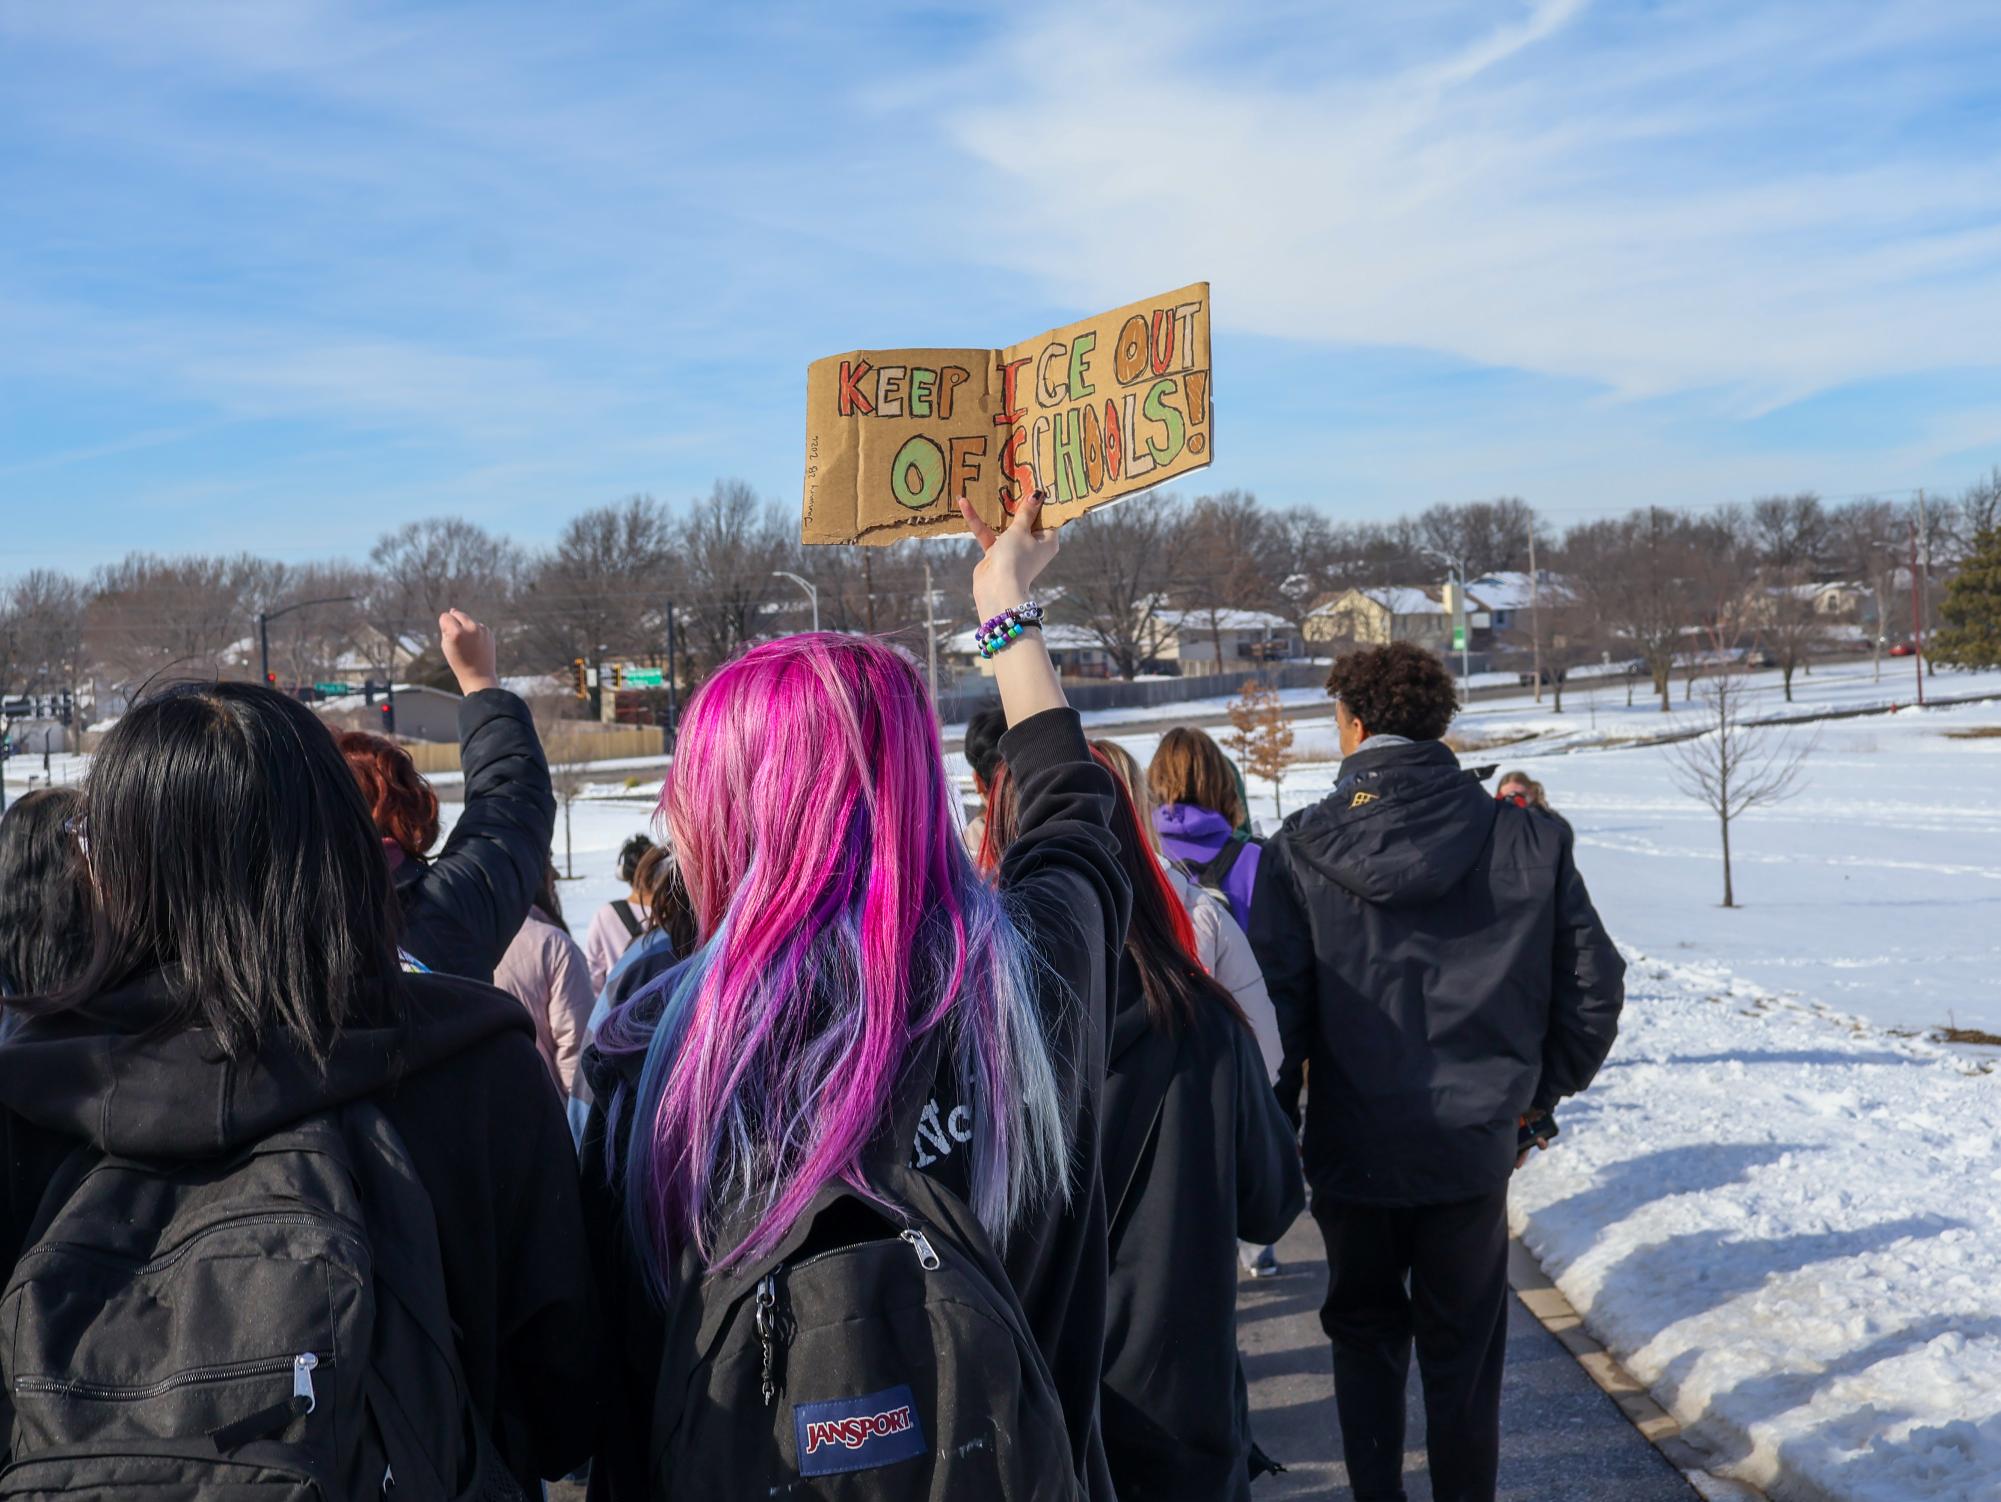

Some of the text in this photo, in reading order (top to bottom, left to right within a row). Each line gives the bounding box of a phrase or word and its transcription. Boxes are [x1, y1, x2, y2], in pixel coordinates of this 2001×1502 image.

[838, 301, 1202, 426] KEEP ICE OUT
[890, 369, 1209, 517] OF SCHOOLS!
[804, 484, 819, 528] January
[806, 1406, 911, 1454] JANSPORT
